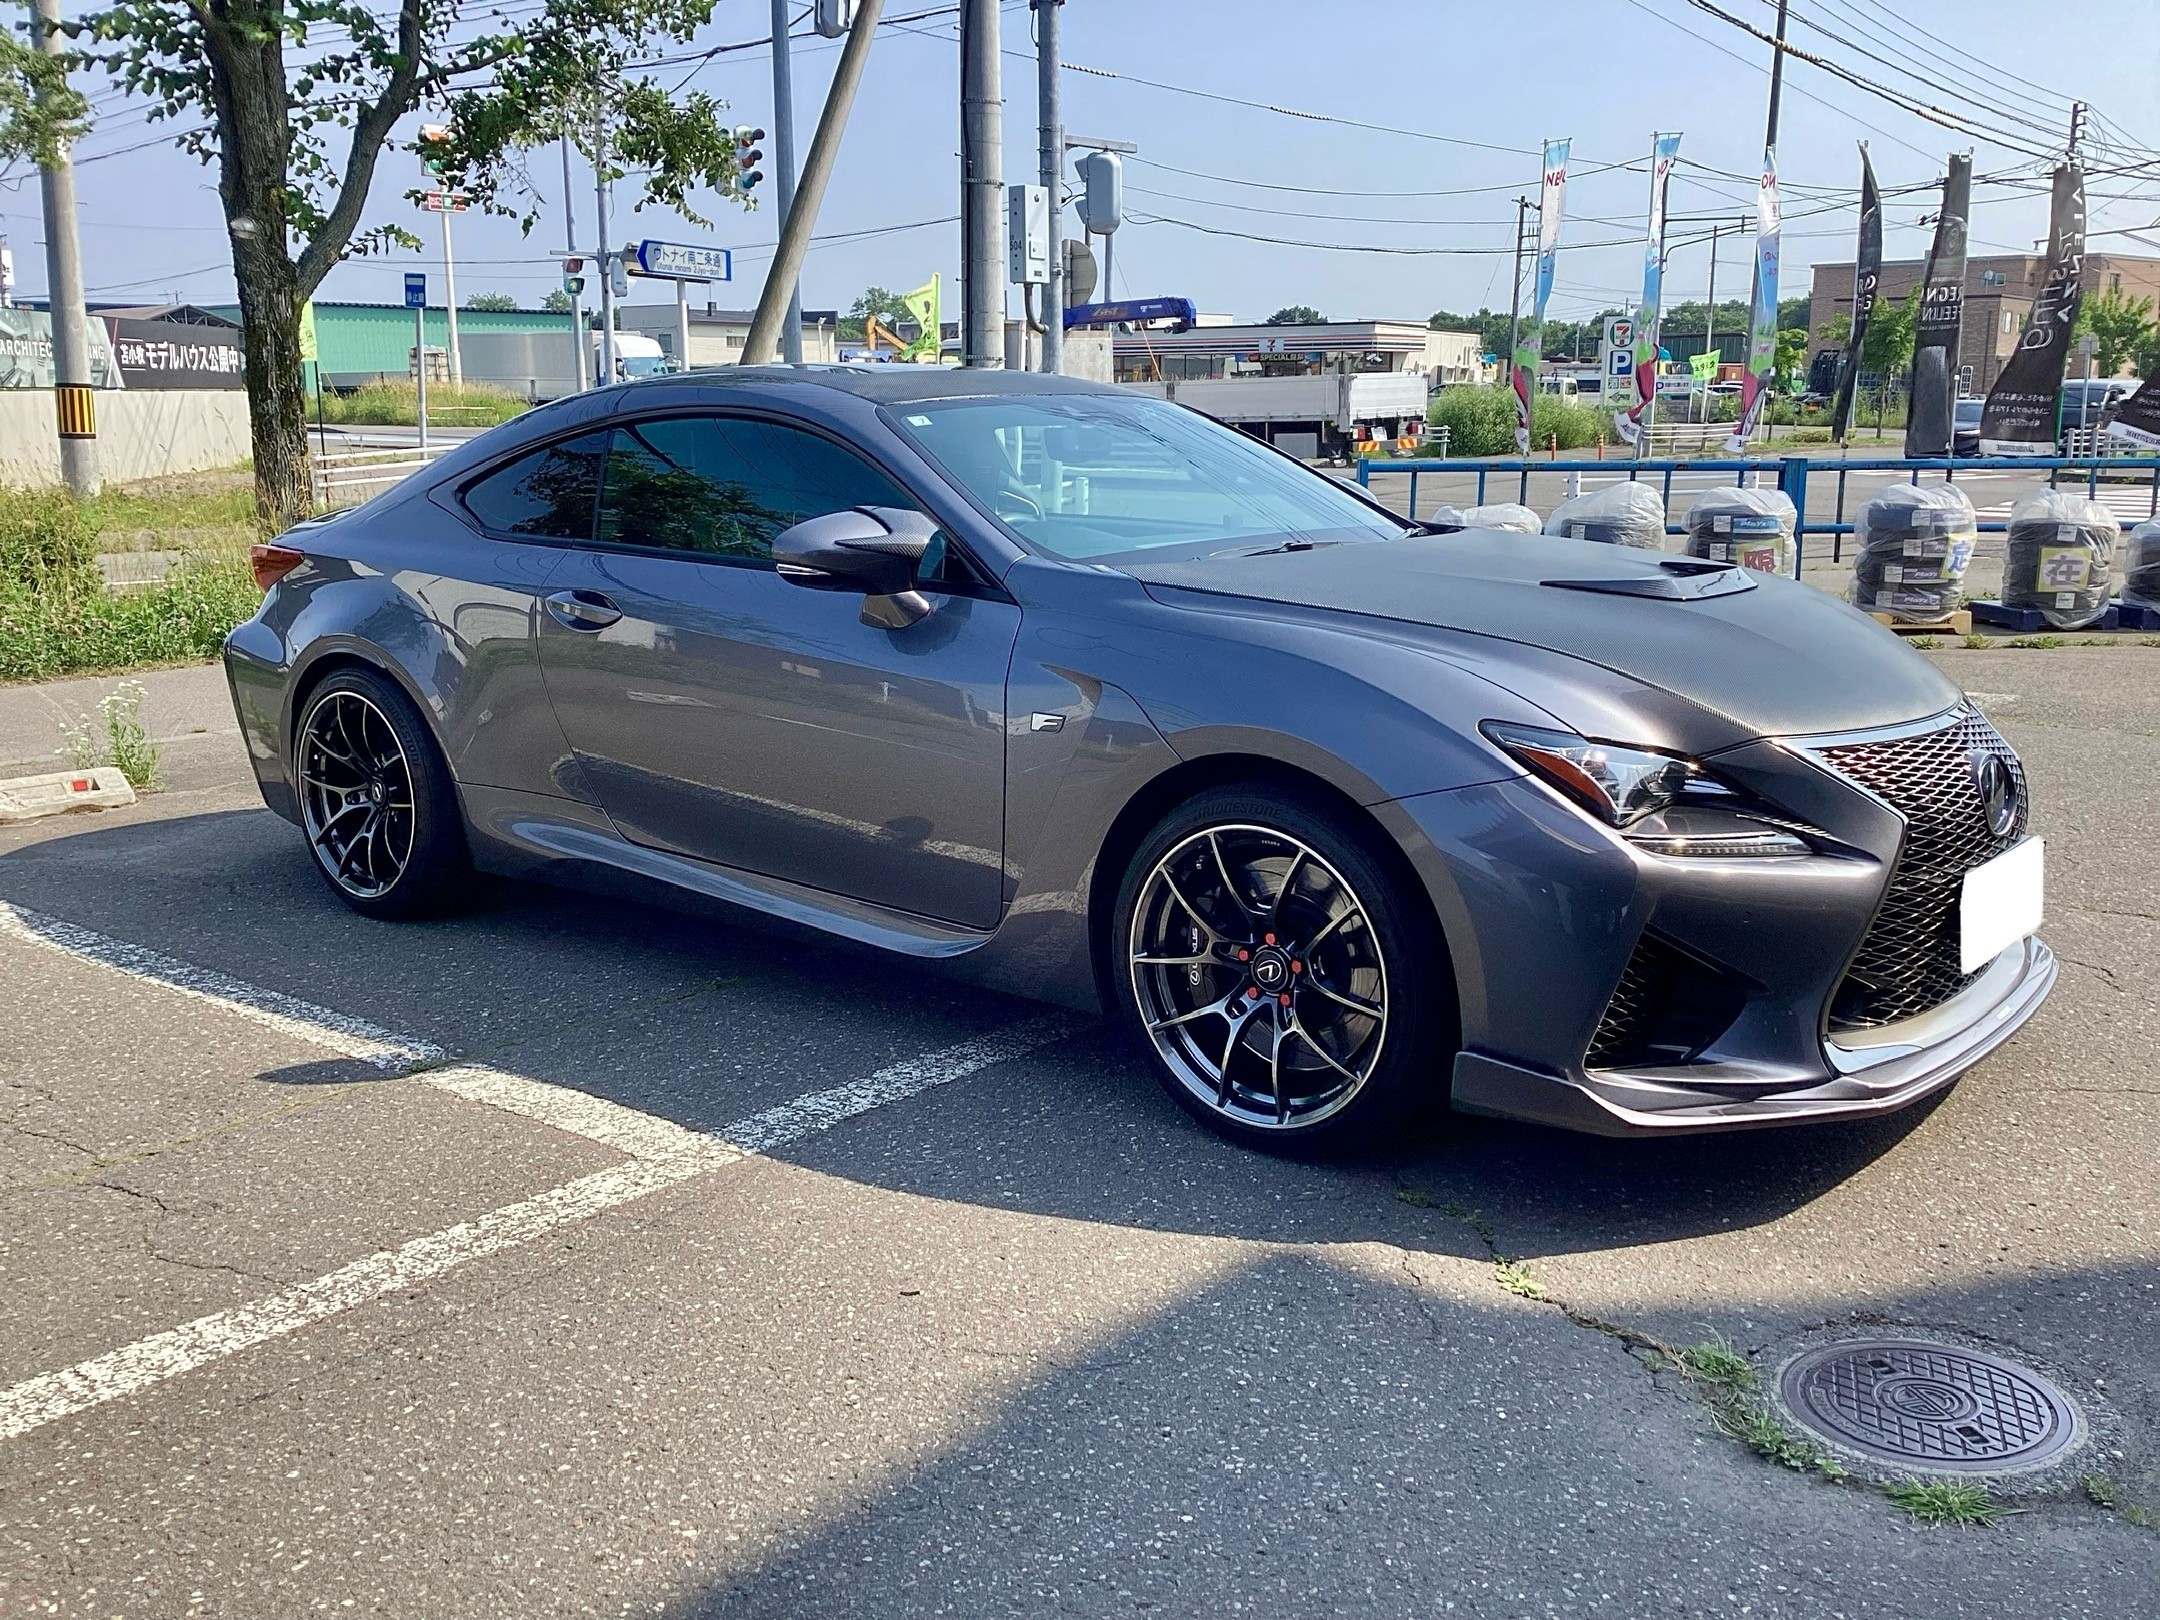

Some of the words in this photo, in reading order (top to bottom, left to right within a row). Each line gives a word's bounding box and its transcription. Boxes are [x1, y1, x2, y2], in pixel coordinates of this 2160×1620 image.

[653, 246, 721, 268] ウトナイ南二条通
[0, 338, 53, 358] ARCHITEC
[1611, 351, 1632, 375] P
[2045, 555, 2083, 586] 在
